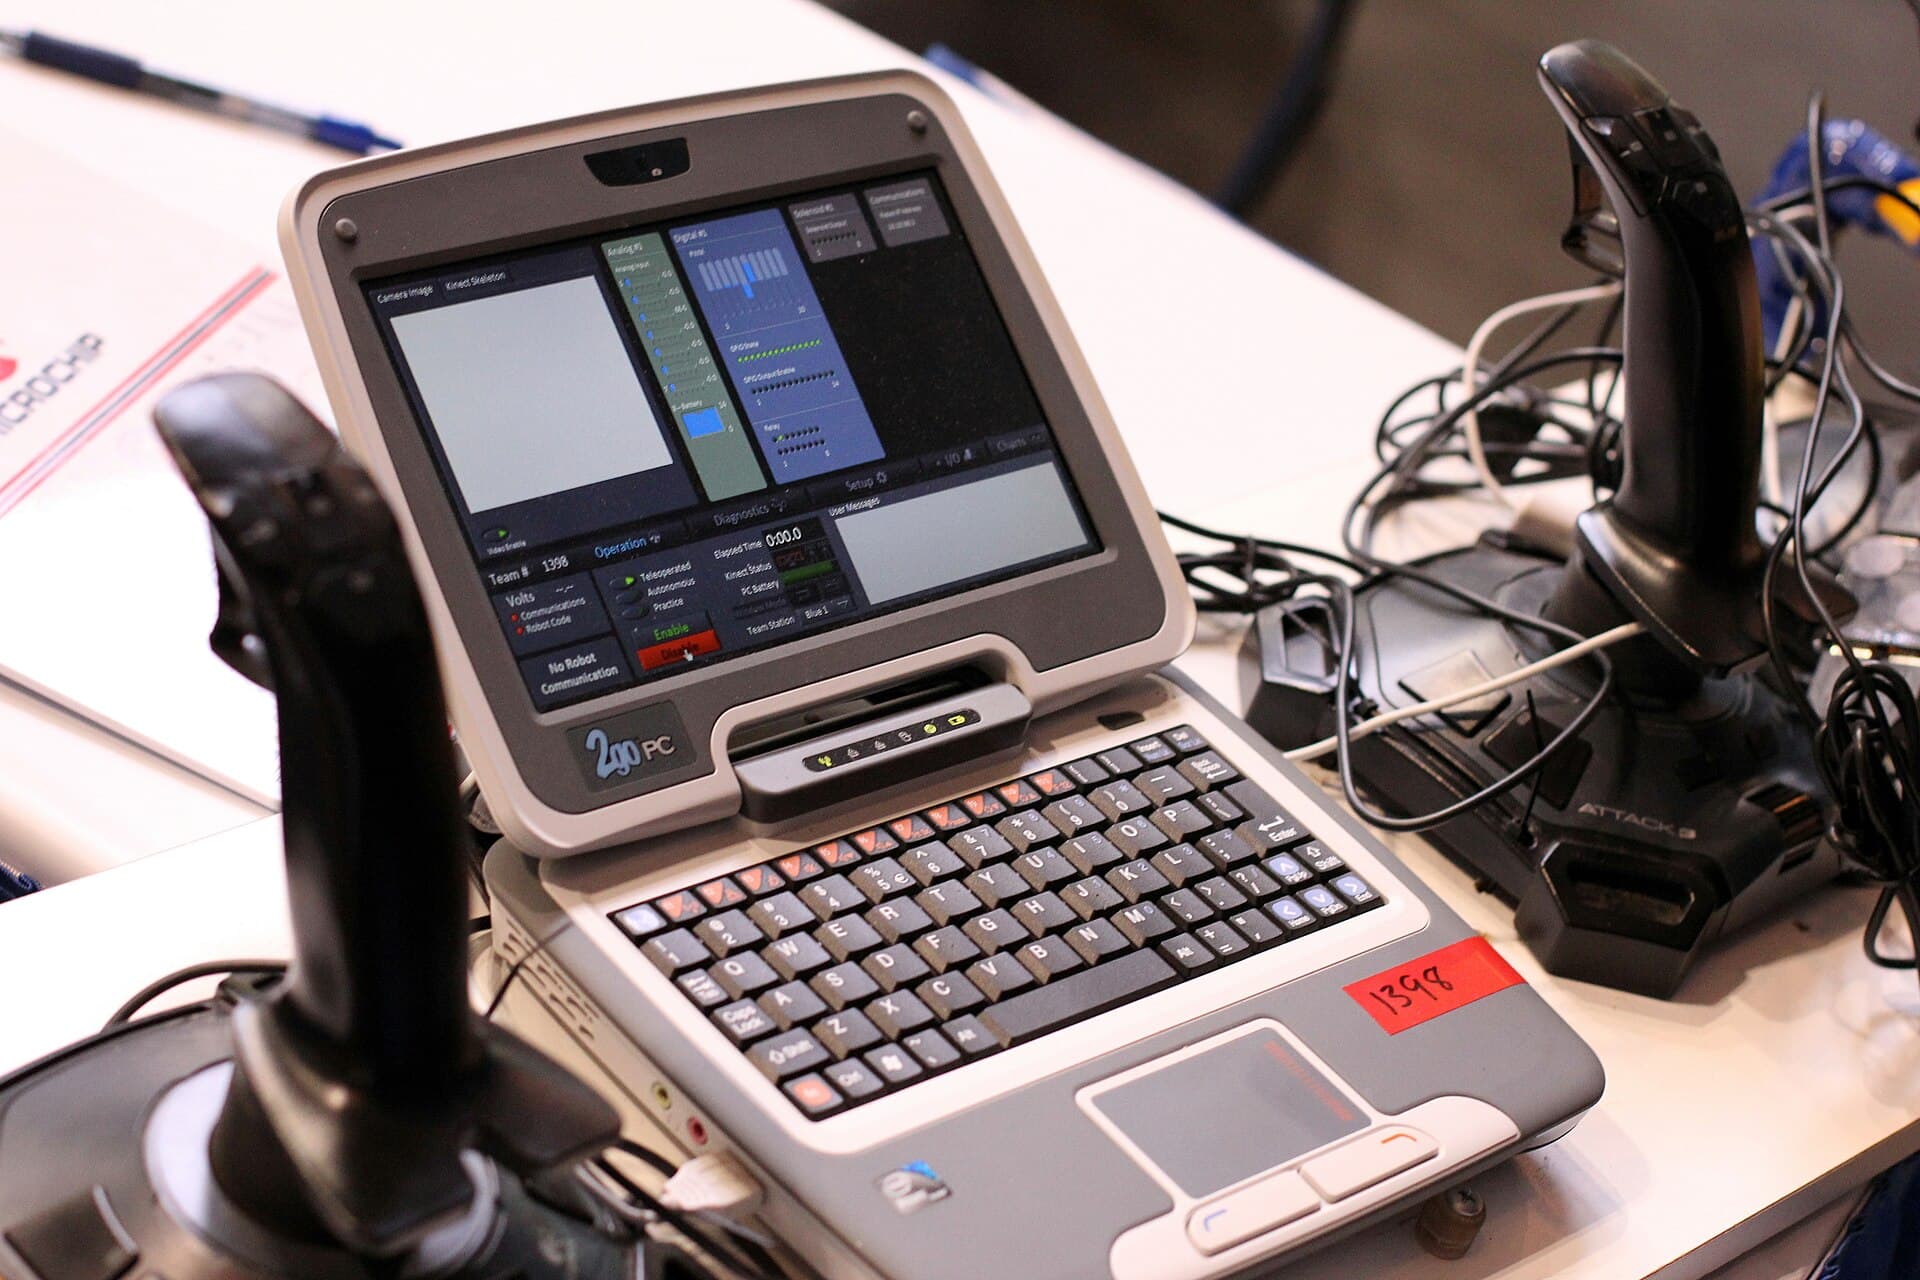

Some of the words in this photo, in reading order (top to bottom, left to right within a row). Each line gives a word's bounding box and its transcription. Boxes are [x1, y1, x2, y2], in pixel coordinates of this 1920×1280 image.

[444, 277, 471, 290] Kinect
[469, 271, 506, 286] Skeleton
[376, 290, 408, 304] Camera
[407, 285, 433, 297] Image
[844, 476, 874, 491] Setup
[826, 504, 846, 517] User
[844, 495, 882, 514] Messages
[712, 503, 769, 526] Diagnostics
[593, 537, 647, 558] Operation
[713, 543, 743, 559] Elapsed
[741, 539, 762, 551] Time
[765, 526, 802, 547] 0:00.0
[487, 570, 520, 585] Team
[541, 554, 569, 572] 1398
[639, 560, 691, 581] Teleoperated
[723, 567, 749, 580] Kinect
[746, 561, 772, 575] Status
[647, 577, 696, 596] Autonomous
[740, 584, 753, 596] PC
[751, 579, 779, 593] Battery
[504, 591, 535, 607] Volts
[652, 597, 684, 611] Practice
[519, 596, 586, 621] Communications
[803, 607, 823, 619] Blue
[525, 619, 551, 633] Robot
[549, 614, 571, 627] Code
[652, 621, 689, 640] Enable
[745, 621, 772, 635] Team
[767, 615, 795, 630] Station
[547, 661, 565, 674] No
[564, 652, 597, 669] Robot
[540, 665, 618, 694] Communication
[641, 735, 675, 760] PC
[1114, 799, 1129, 811] 0
[1069, 814, 1083, 825] 9
[1162, 808, 1177, 822] P
[1578, 803, 1675, 836] ATTACK
[1022, 828, 1037, 840] 8
[1267, 826, 1297, 842] Enter
[974, 844, 987, 856] 7
[1024, 854, 1044, 868] U
[1163, 852, 1182, 865] L
[1315, 855, 1342, 870] Shift
[926, 861, 941, 873] 6
[1118, 866, 1139, 880] K
[876, 878, 891, 890] 5
[977, 870, 995, 884] Y
[927, 887, 945, 901] T
[1075, 883, 1089, 897] J
[828, 896, 840, 907] 4
[1023, 899, 1045, 914] H
[773, 913, 789, 926] 3
[878, 905, 899, 920] R
[1123, 908, 1146, 923] M
[827, 922, 848, 938] E
[977, 916, 998, 931] G
[720, 931, 737, 945] 2
[925, 933, 940, 949] F
[1077, 926, 1099, 941] N
[775, 939, 798, 956] W
[1028, 944, 1048, 959] B
[723, 960, 745, 976] Q
[874, 952, 894, 968] D
[979, 960, 997, 975] V
[824, 971, 844, 987] S
[931, 980, 951, 995] C
[1369, 966, 1454, 1015] 1398
[773, 990, 792, 1006] A
[878, 997, 900, 1014] X
[826, 1017, 847, 1035] Z
